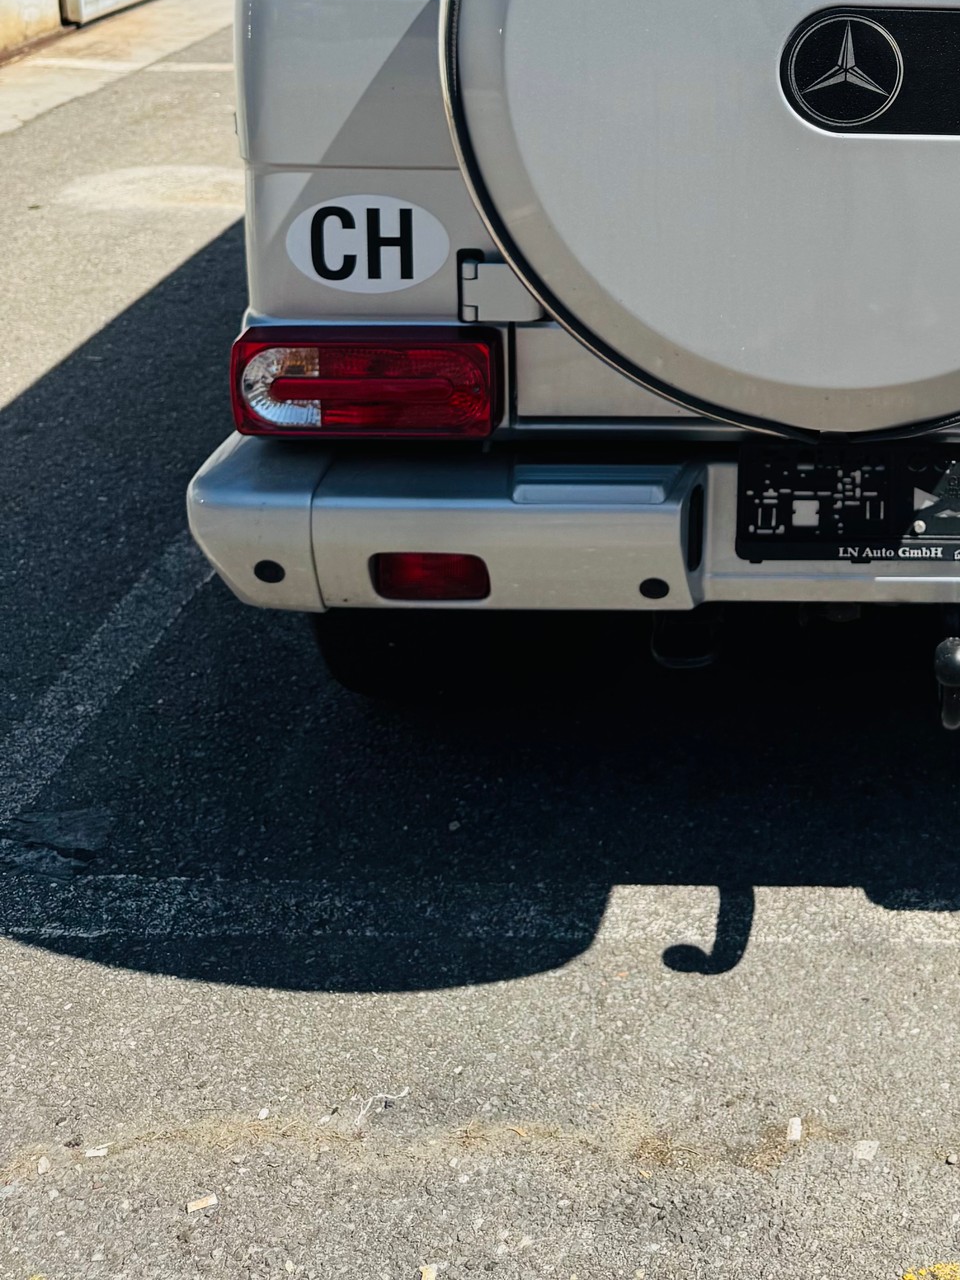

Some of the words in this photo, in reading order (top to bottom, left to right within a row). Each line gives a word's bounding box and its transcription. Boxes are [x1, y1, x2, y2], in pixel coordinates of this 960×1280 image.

[310, 205, 414, 281] CH
[838, 547, 859, 557] LN
[863, 546, 895, 558] Auto
[898, 546, 943, 558] GmbH
